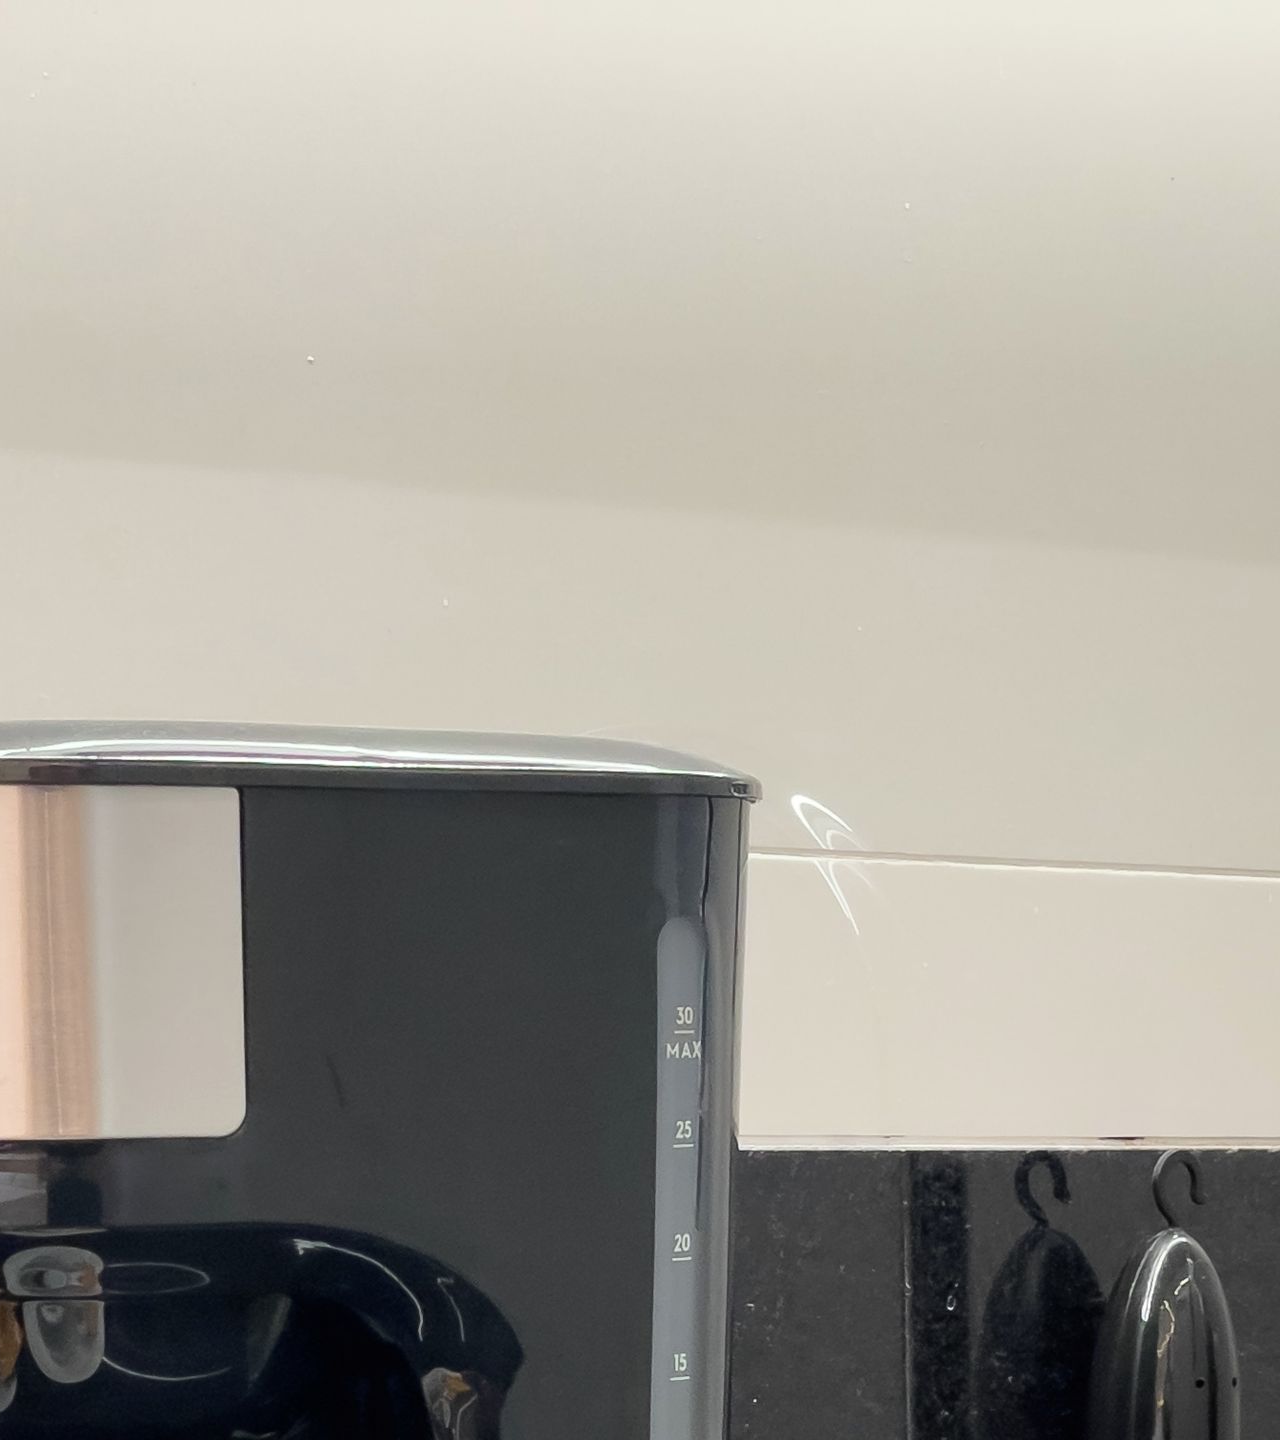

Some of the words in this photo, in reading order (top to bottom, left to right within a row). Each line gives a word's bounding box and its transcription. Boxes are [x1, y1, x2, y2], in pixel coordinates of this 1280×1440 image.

[676, 1006, 694, 1025] 30
[666, 1040, 702, 1060] MAX
[675, 1120, 692, 1139] 25
[673, 1233, 691, 1252] 20
[673, 1353, 688, 1372] 15
